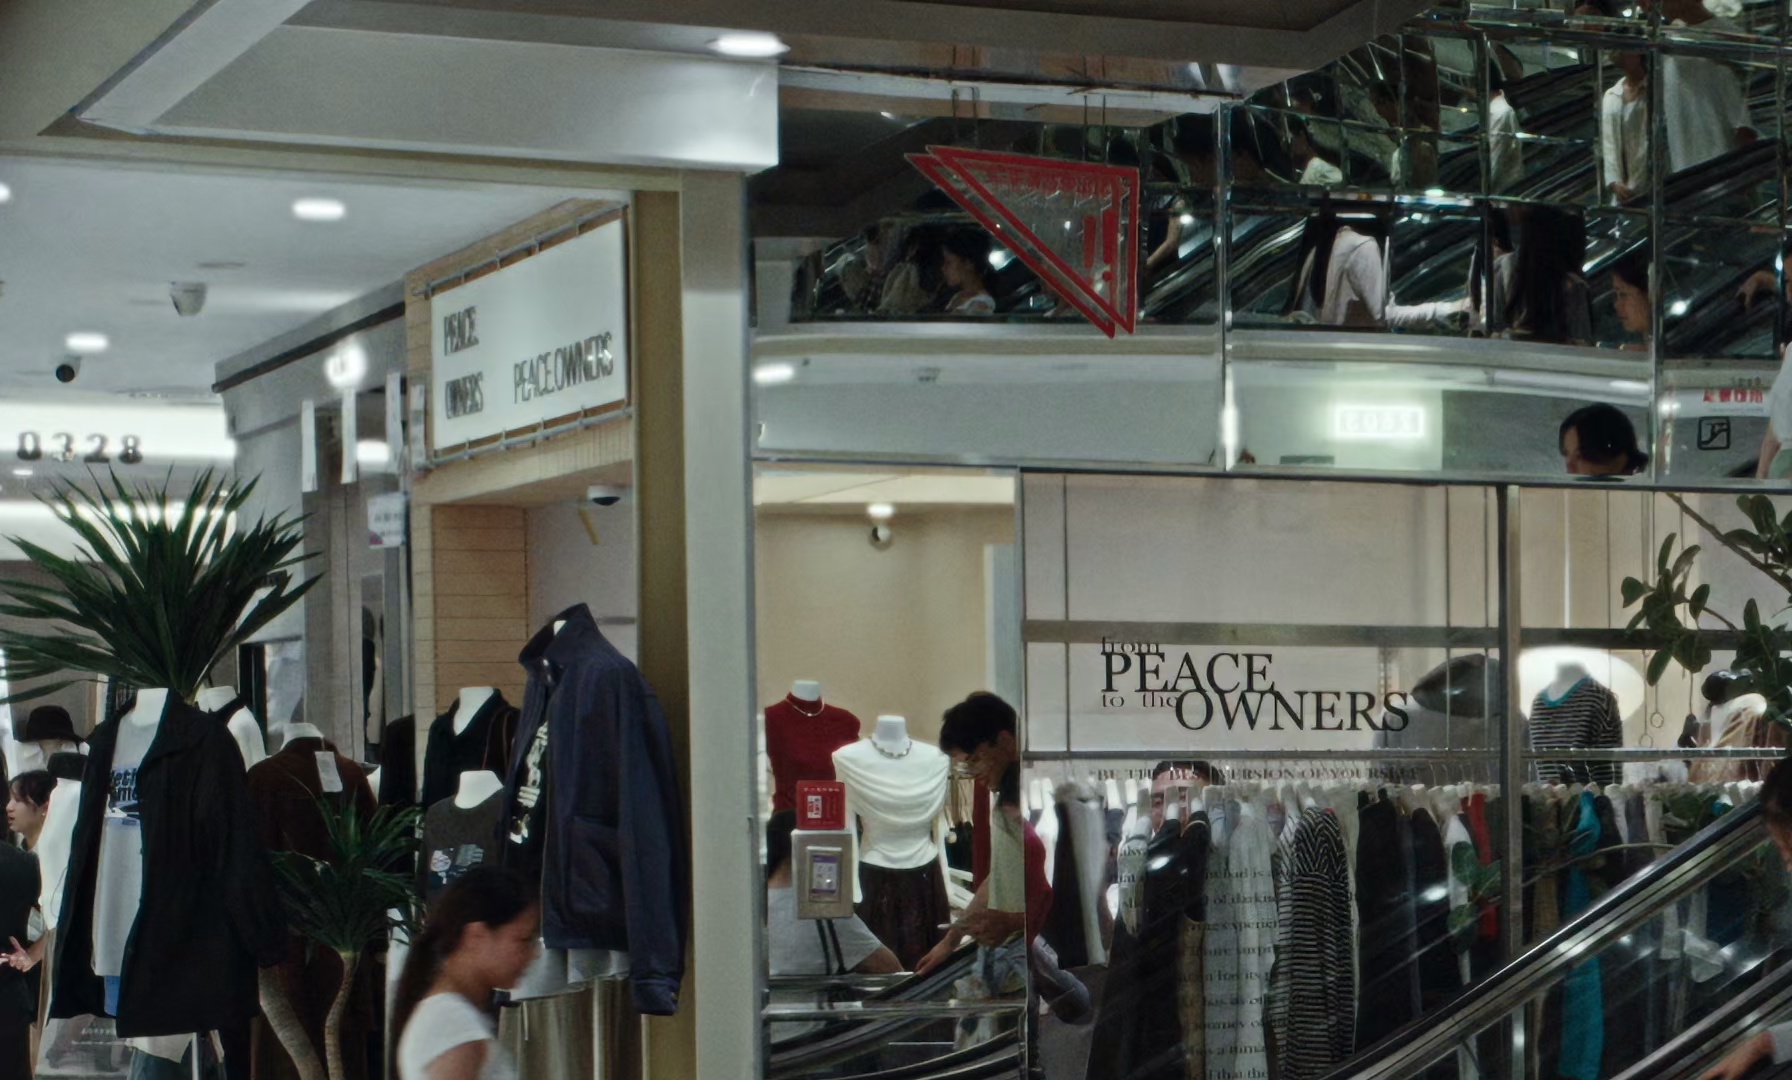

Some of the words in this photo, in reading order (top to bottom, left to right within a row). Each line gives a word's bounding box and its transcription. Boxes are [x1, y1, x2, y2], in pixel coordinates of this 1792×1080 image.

[1100, 651, 1275, 693] PEACE
[1102, 692, 1125, 708] to
[1142, 691, 1178, 708] the
[1175, 690, 1409, 731] OWNERS
